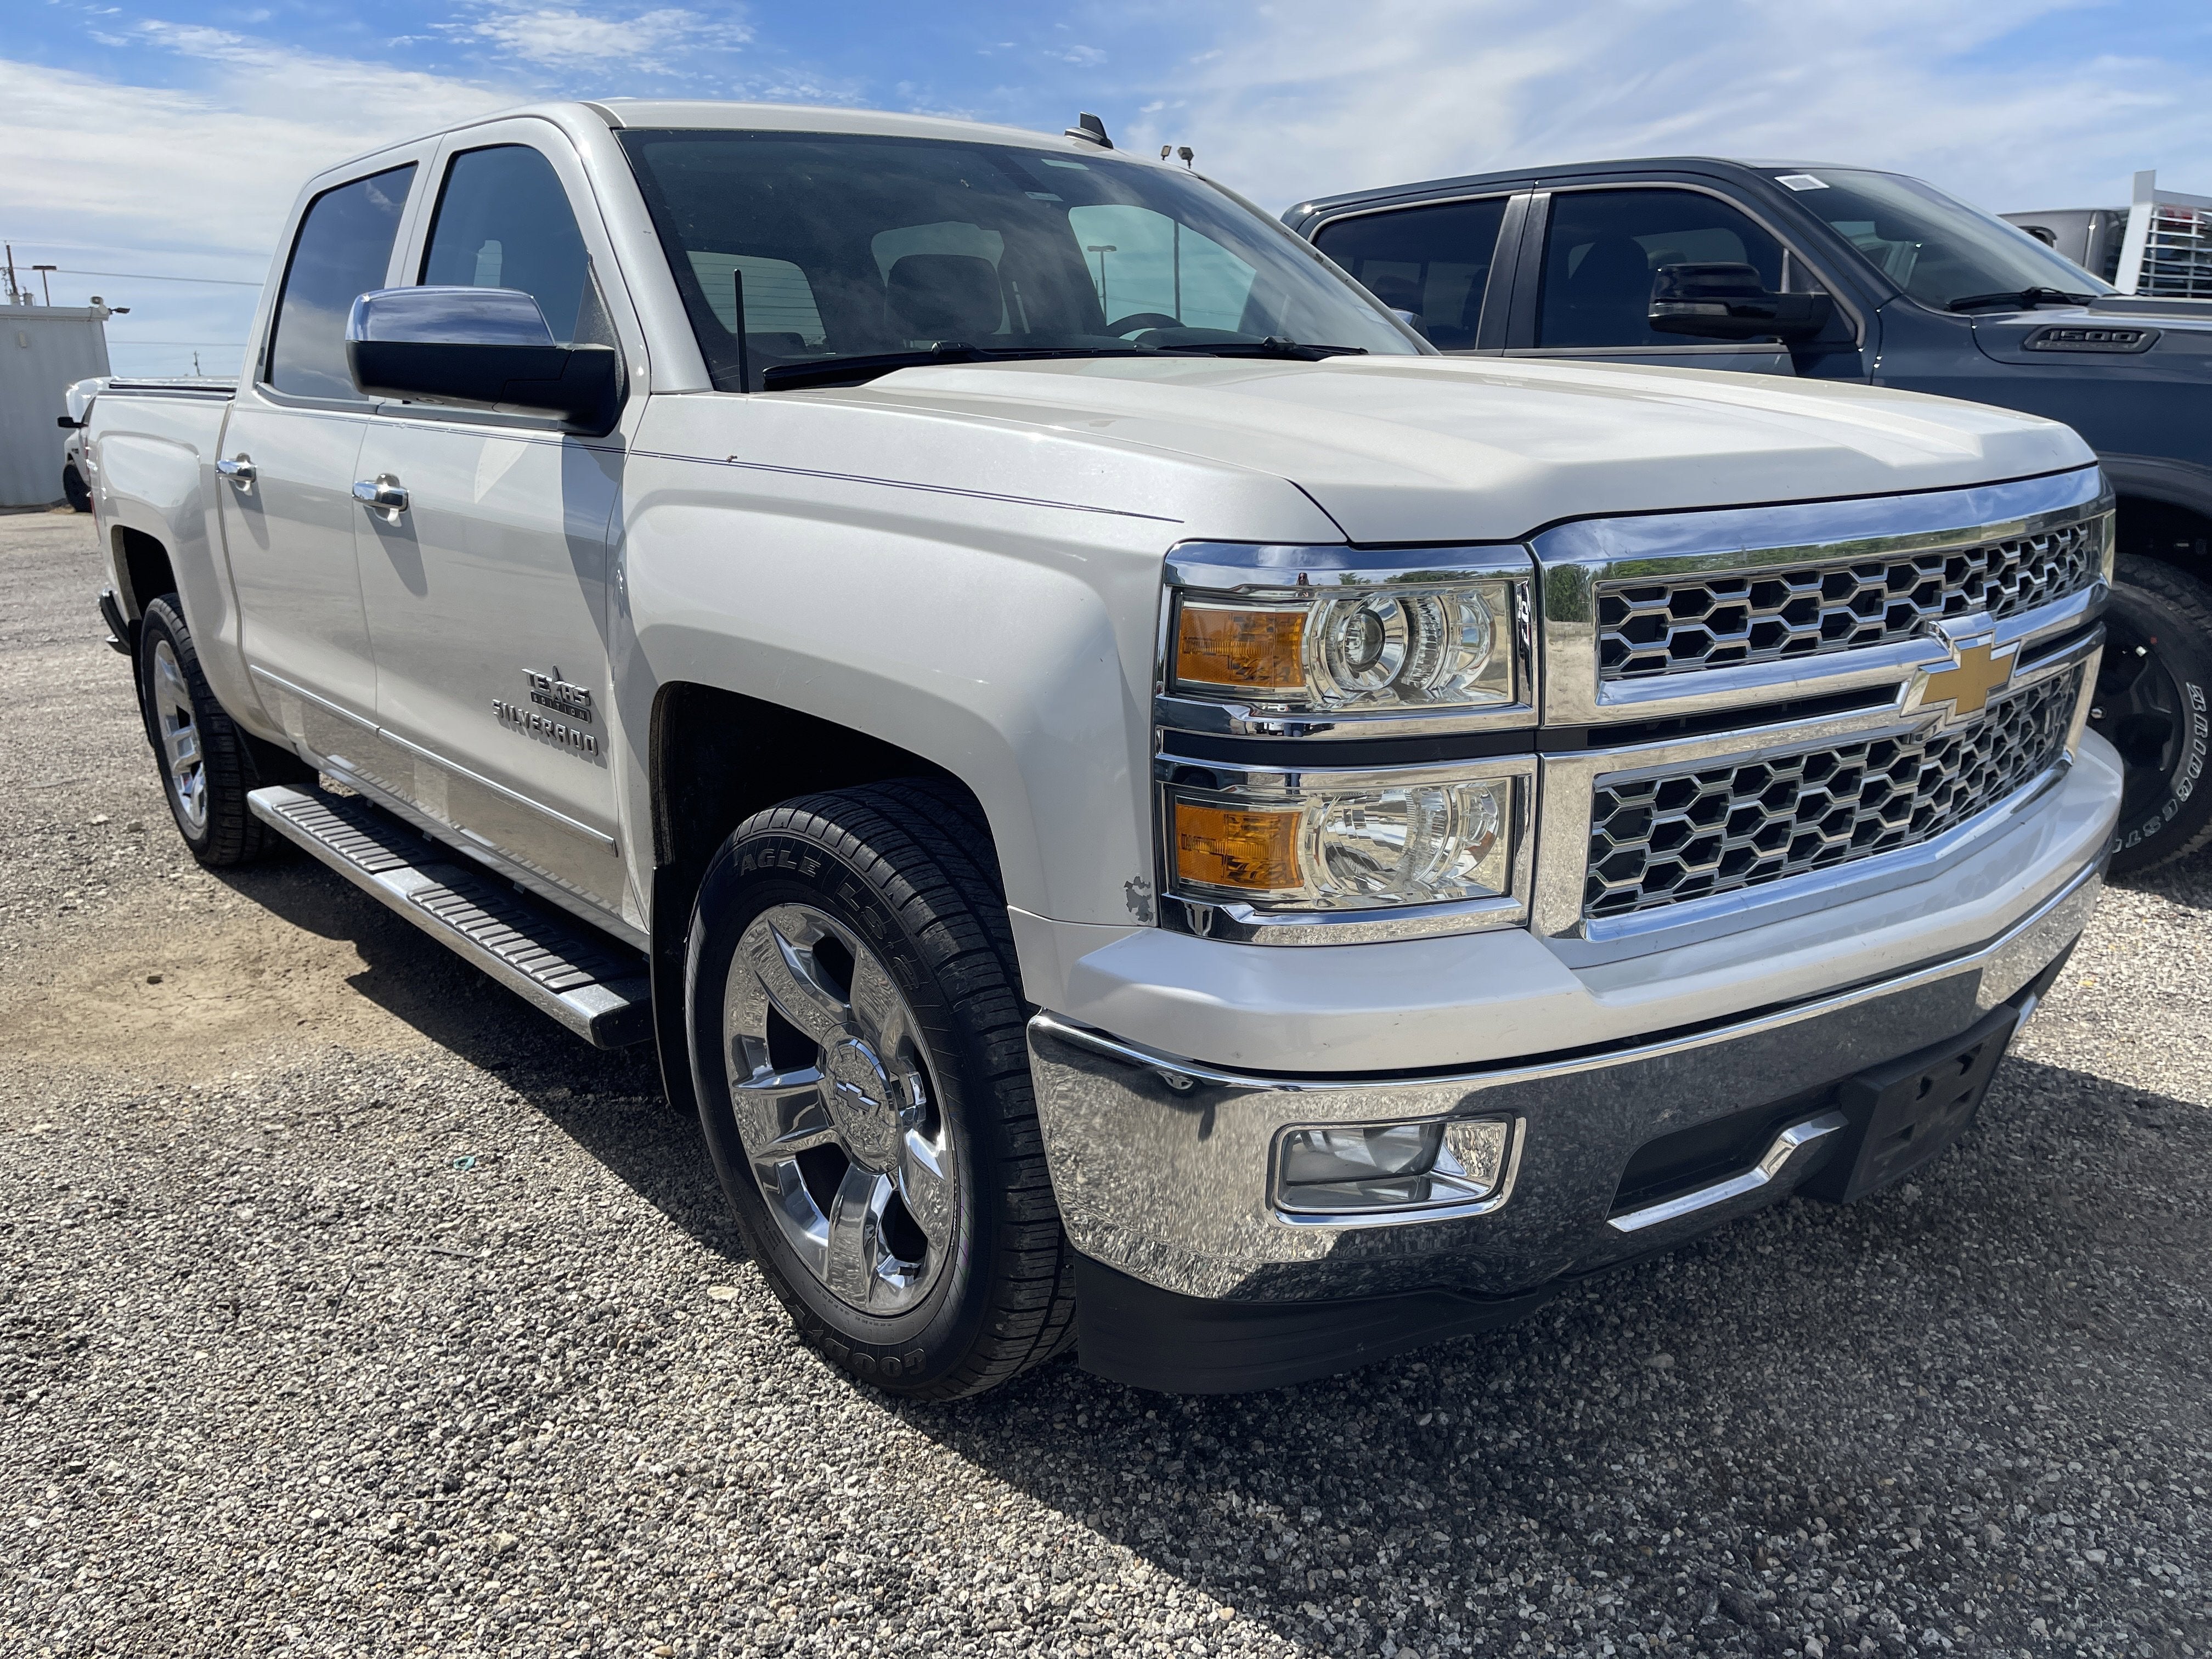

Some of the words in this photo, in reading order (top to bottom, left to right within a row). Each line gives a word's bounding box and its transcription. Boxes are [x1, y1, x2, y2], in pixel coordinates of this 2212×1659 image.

[2050, 330, 2137, 343] 1500
[532, 693, 586, 720] EDITION
[492, 698, 599, 757] SILVERADO
[734, 848, 821, 878] AGLE
